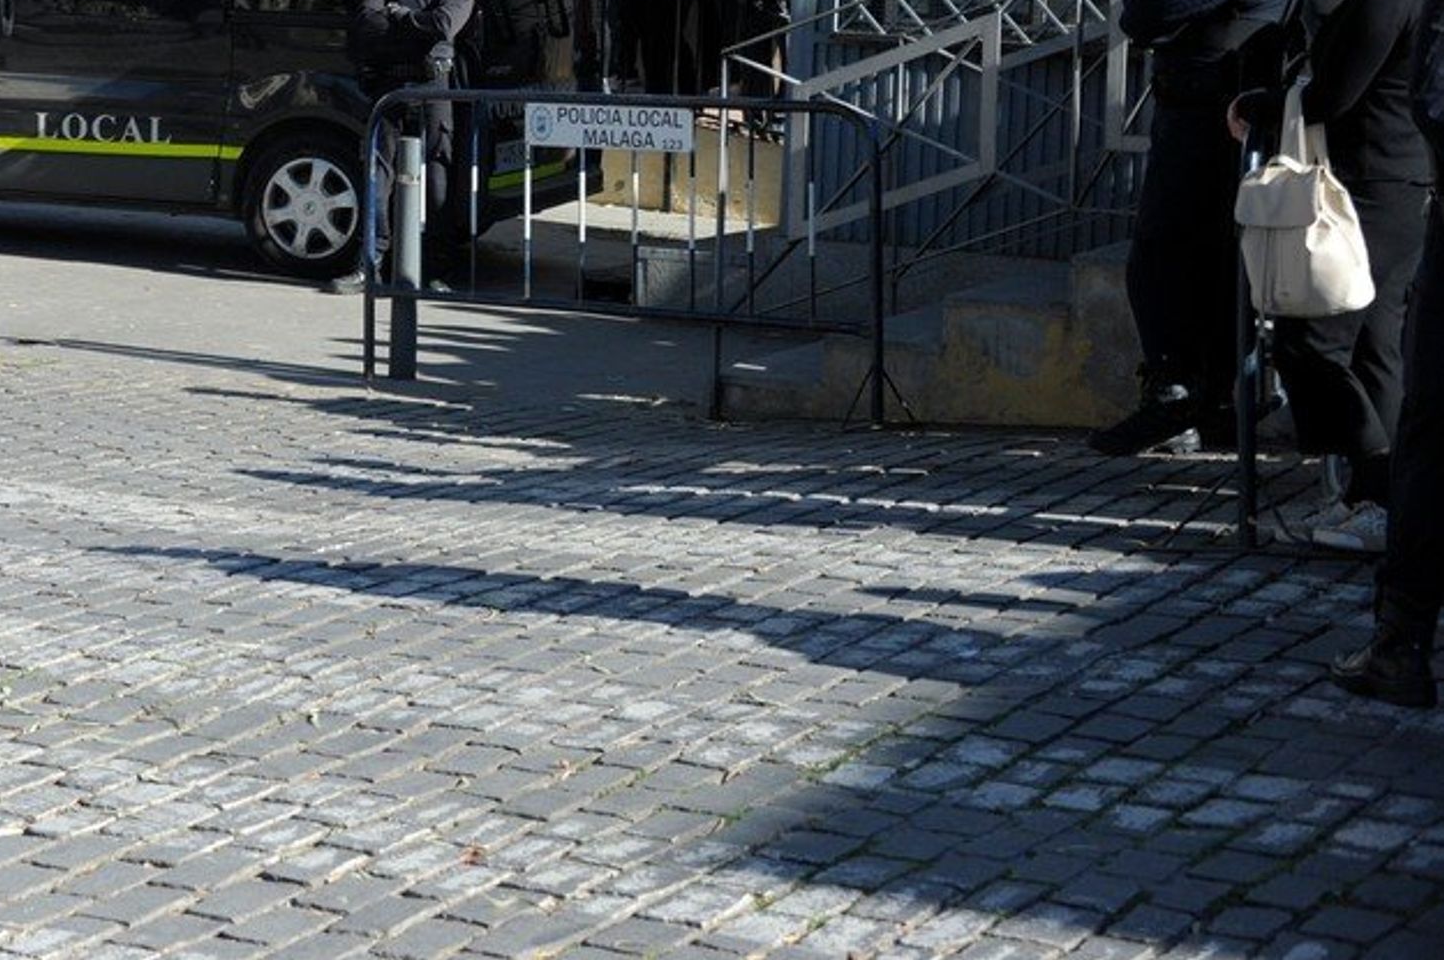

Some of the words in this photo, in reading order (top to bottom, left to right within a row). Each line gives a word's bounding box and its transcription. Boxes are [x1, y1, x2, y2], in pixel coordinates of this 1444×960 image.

[35, 111, 172, 145] LOCAL
[557, 106, 623, 125] POLICIA
[628, 109, 683, 129] LOCAL
[583, 129, 656, 148] MALAGA
